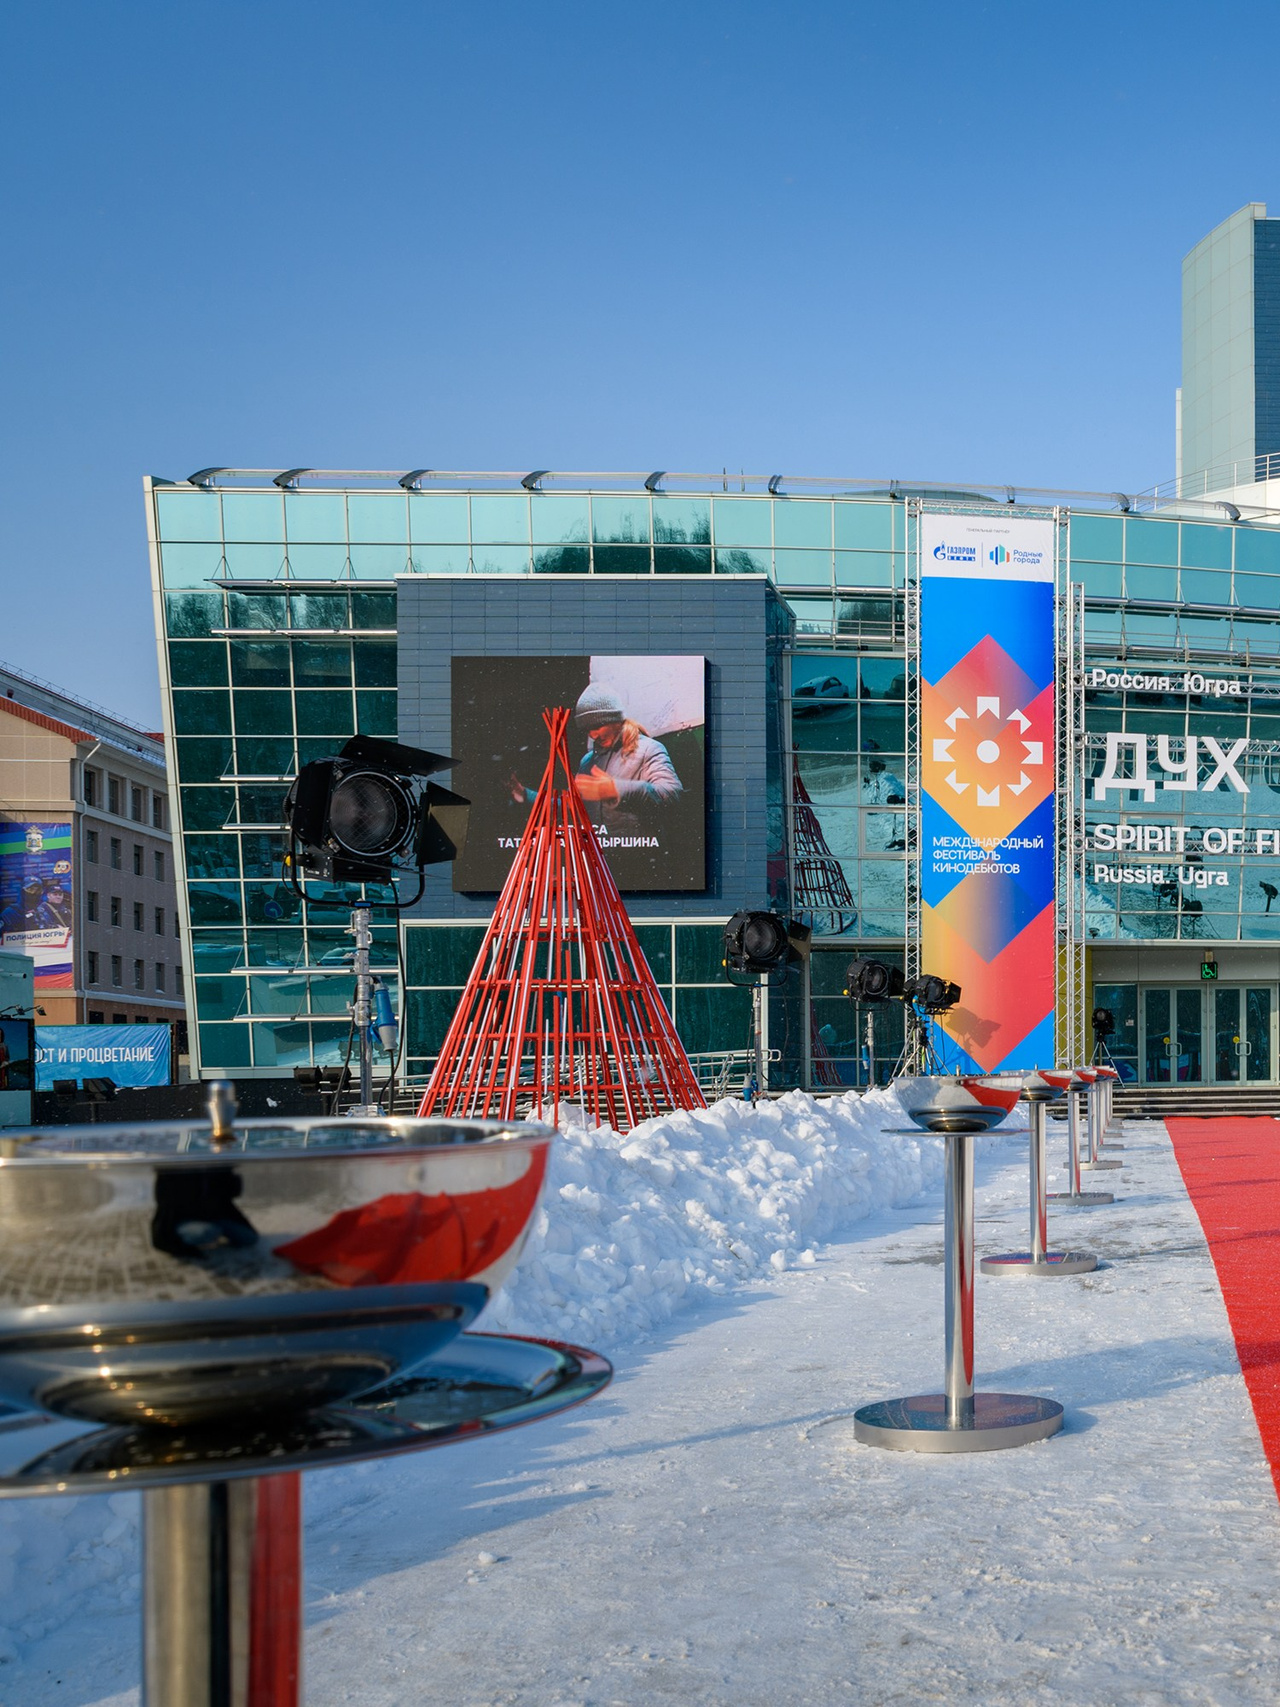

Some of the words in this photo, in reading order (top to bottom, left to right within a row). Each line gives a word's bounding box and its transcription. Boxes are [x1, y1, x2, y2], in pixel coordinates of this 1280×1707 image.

[947, 546, 976, 555] ГАЗПРОМ
[1013, 549, 1043, 558] Родные
[1091, 668, 1175, 691] Россия.
[1183, 671, 1242, 698] Югра
[1094, 732, 1251, 803] ДУХ
[932, 836, 1044, 849] МЕЖДУНАРОДНЫЙ
[1094, 823, 1191, 852] SPIRIT
[1203, 827, 1243, 854] OF
[932, 850, 1001, 861] ФЕСТИВАЛЬ
[932, 862, 1020, 876] КИНОДЕБЮТОВ
[1094, 864, 1170, 885] Russia.
[1178, 866, 1229, 888] Ugra
[6, 932, 41, 941] ПОЛИЦИЯ
[43, 930, 65, 938] ЮГРЫ
[58, 1048, 67, 1062] И
[70, 1047, 155, 1064] ПРОЦВЕТАНИЕ
